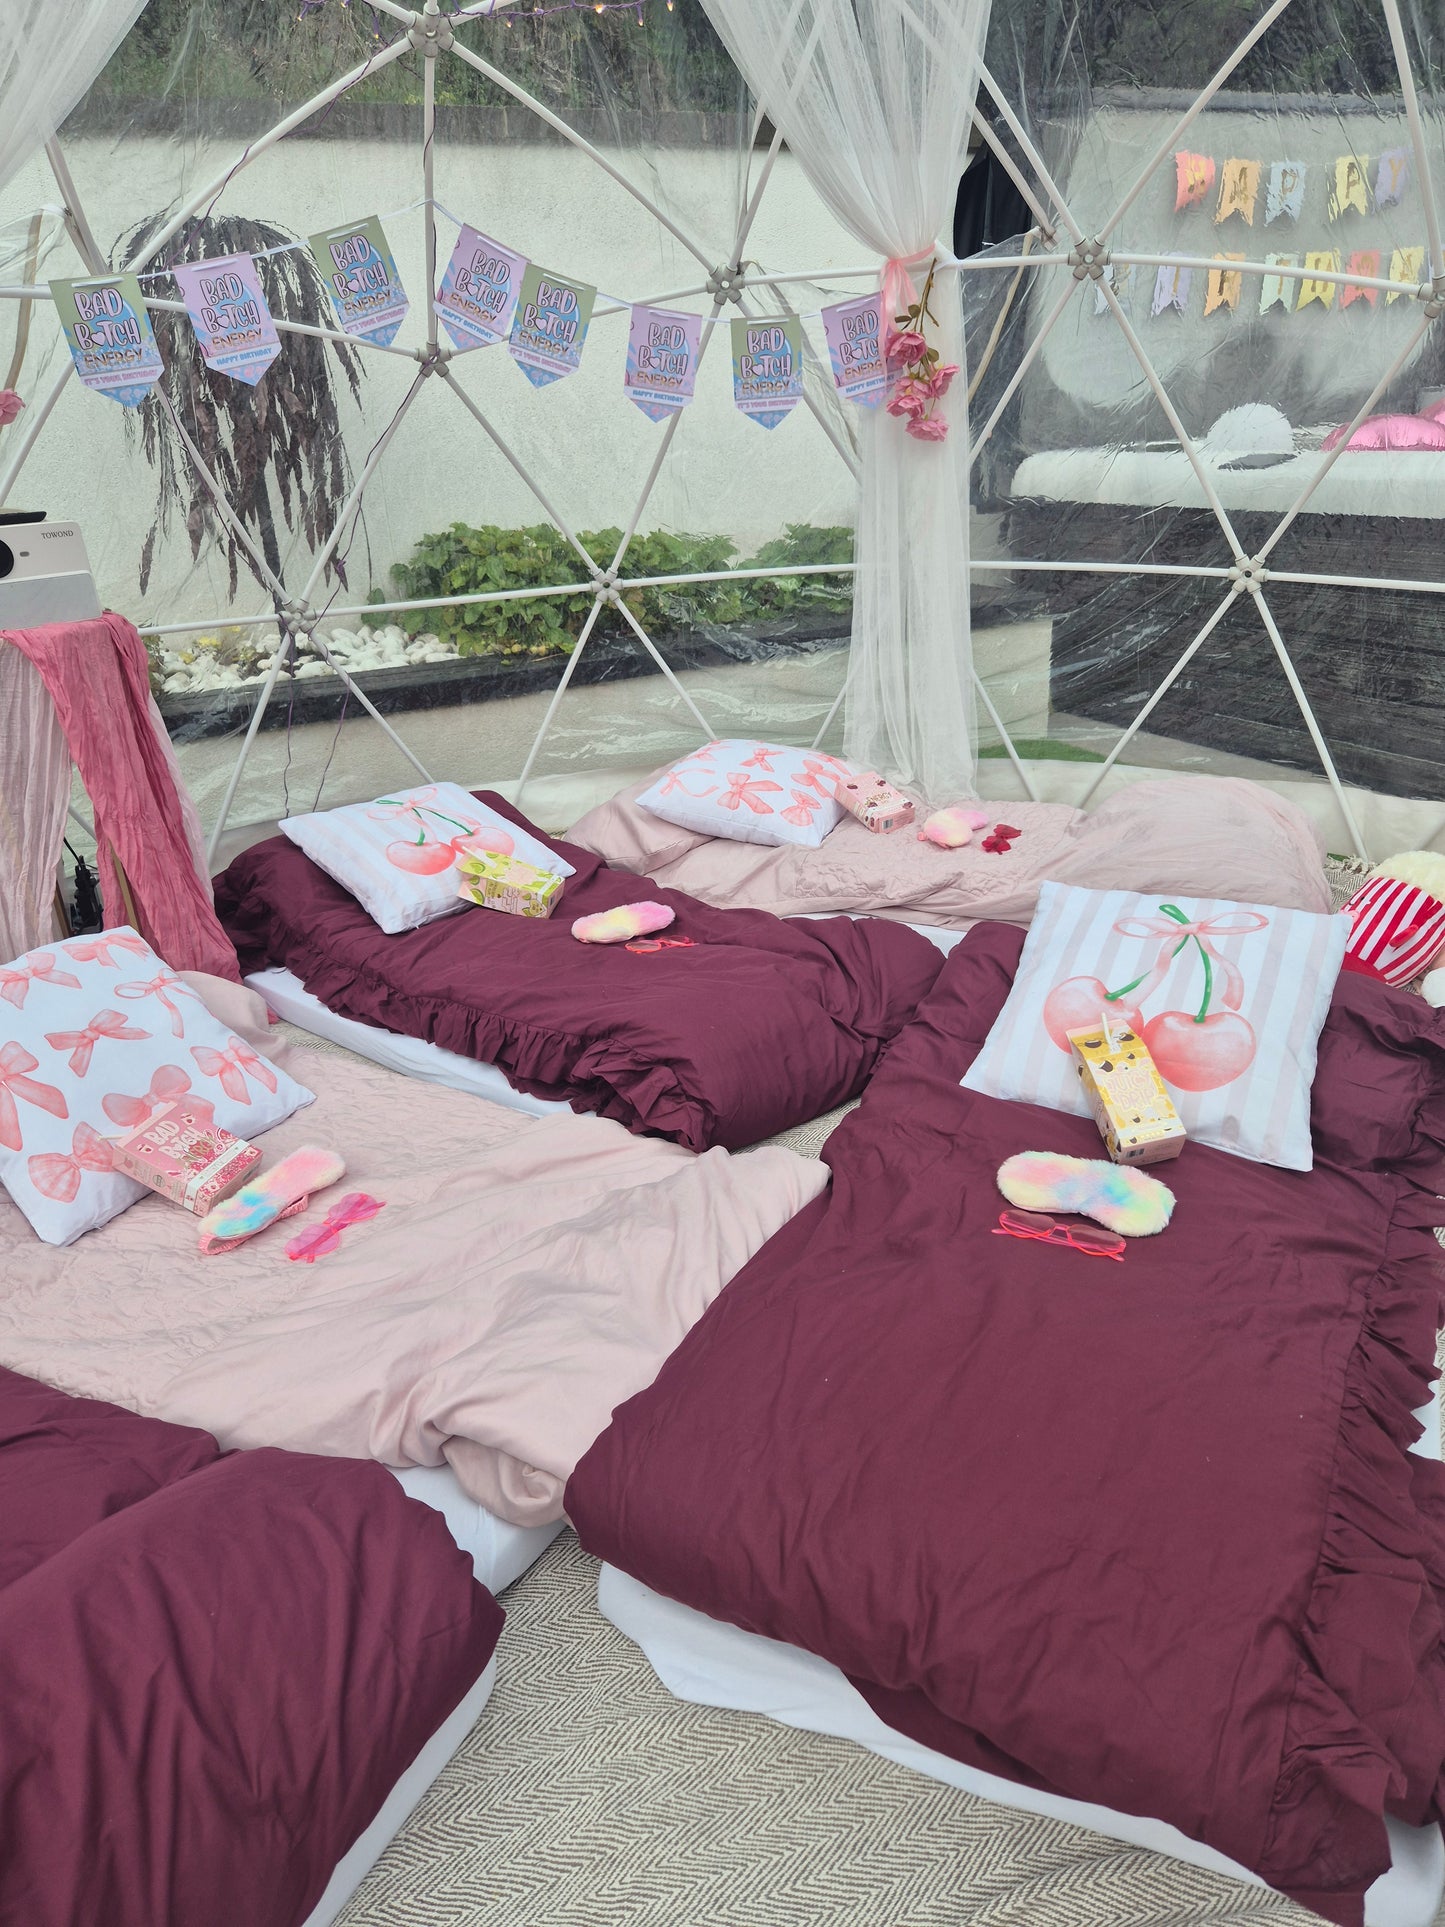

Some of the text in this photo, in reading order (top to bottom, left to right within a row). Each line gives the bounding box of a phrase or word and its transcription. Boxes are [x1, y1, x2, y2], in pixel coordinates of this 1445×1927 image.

[329, 234, 371, 270] BAD
[470, 248, 510, 285] BAD
[200, 273, 243, 306] BAD
[536, 280, 577, 315] BAD
[73, 288, 124, 321] BAD
[343, 289, 391, 317] ENERGY
[449, 292, 497, 324] ENERGY
[442, 308, 494, 339] HAPPY BIRTHDAY
[648, 322, 686, 350] BAD
[841, 309, 879, 341] BAD
[212, 328, 262, 350] ENERGY
[519, 330, 569, 356] ENERGY
[746, 326, 786, 355] BAD
[84, 348, 142, 369] ENERGY
[216, 347, 272, 366] HAPPY BIRTHDAY
[844, 359, 883, 380] ENERG
[636, 370, 683, 387] ENERGY
[741, 379, 790, 395] ENERGY
[845, 373, 895, 394] HAPPY BIRTHAY
[632, 389, 684, 403] HAPPY BIRTHDAY
[41, 530, 74, 540] TOWOND
[1119, 1087, 1155, 1111] DRIP
[143, 1120, 180, 1146] BAD
